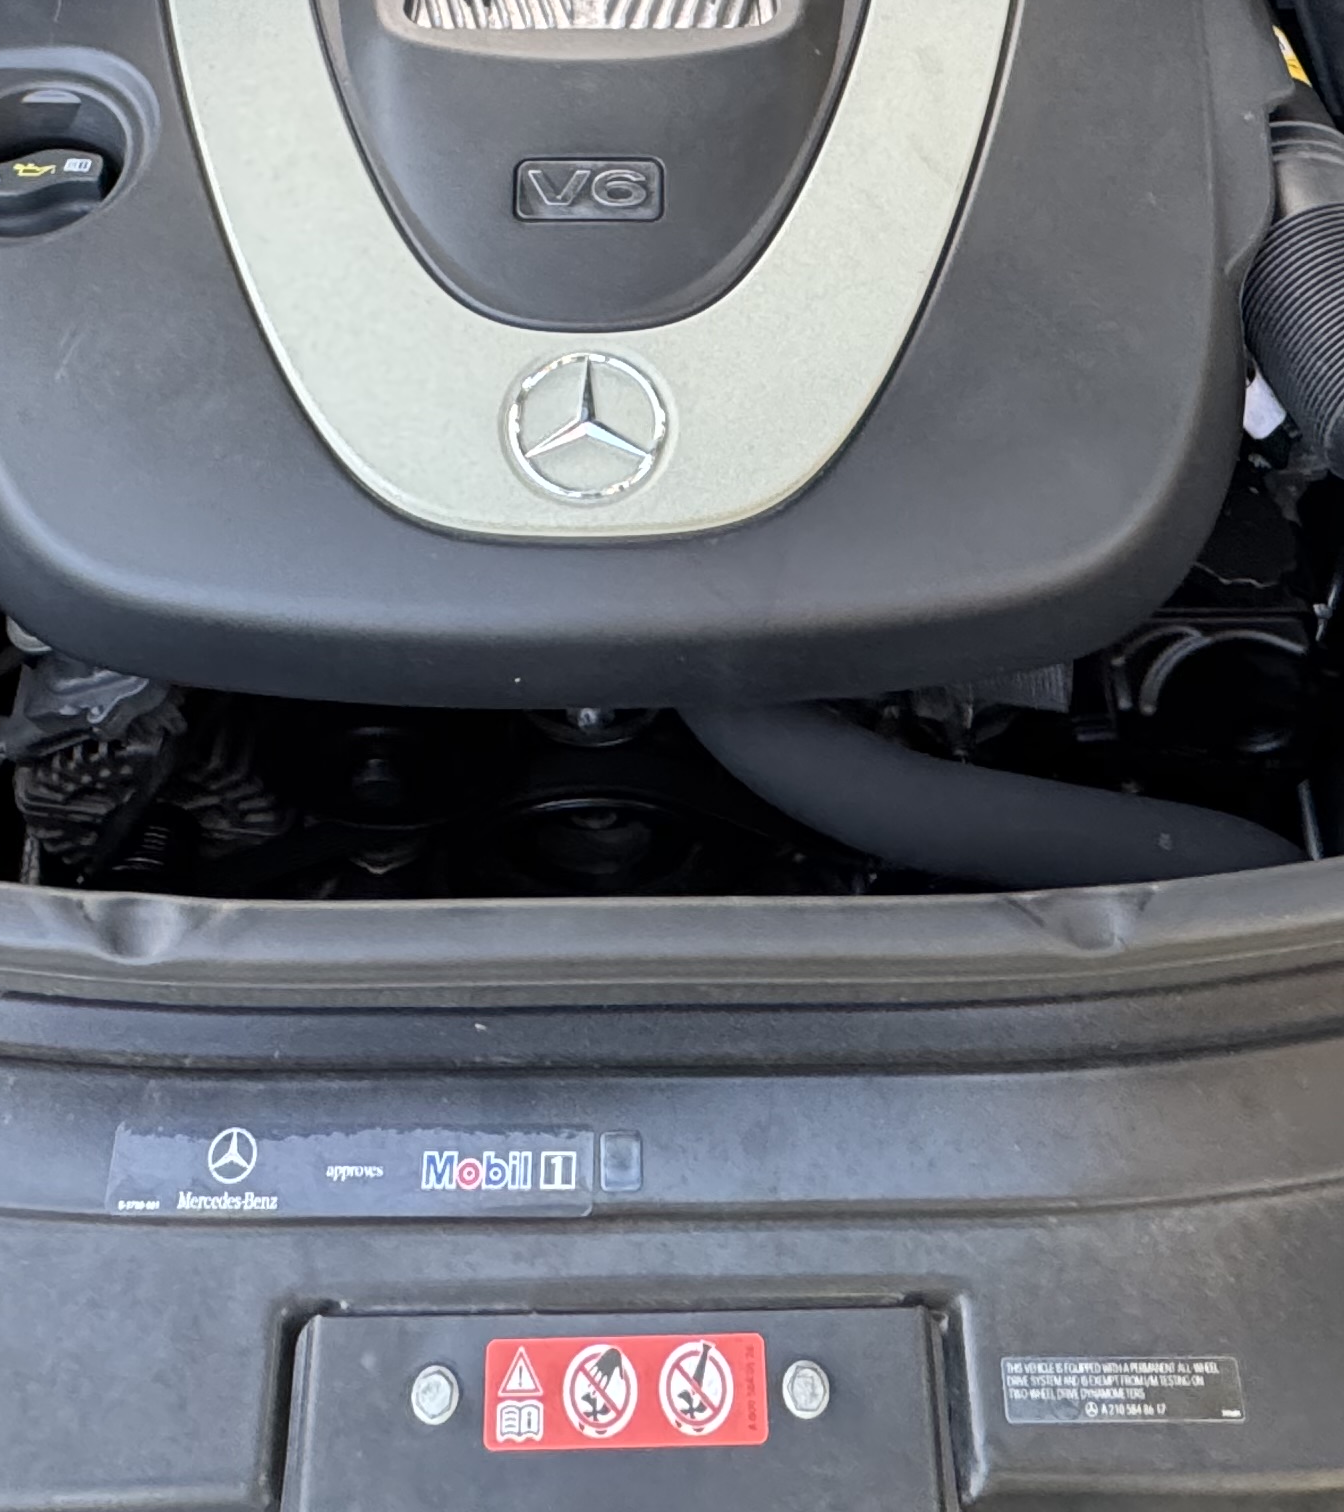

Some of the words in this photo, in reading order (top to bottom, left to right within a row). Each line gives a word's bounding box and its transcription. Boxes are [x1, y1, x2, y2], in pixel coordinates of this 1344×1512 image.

[527, 169, 646, 206] V6
[325, 1164, 384, 1182] approves
[421, 1151, 533, 1190] Mobil
[176, 1191, 278, 1210] Mercedes-Benz
